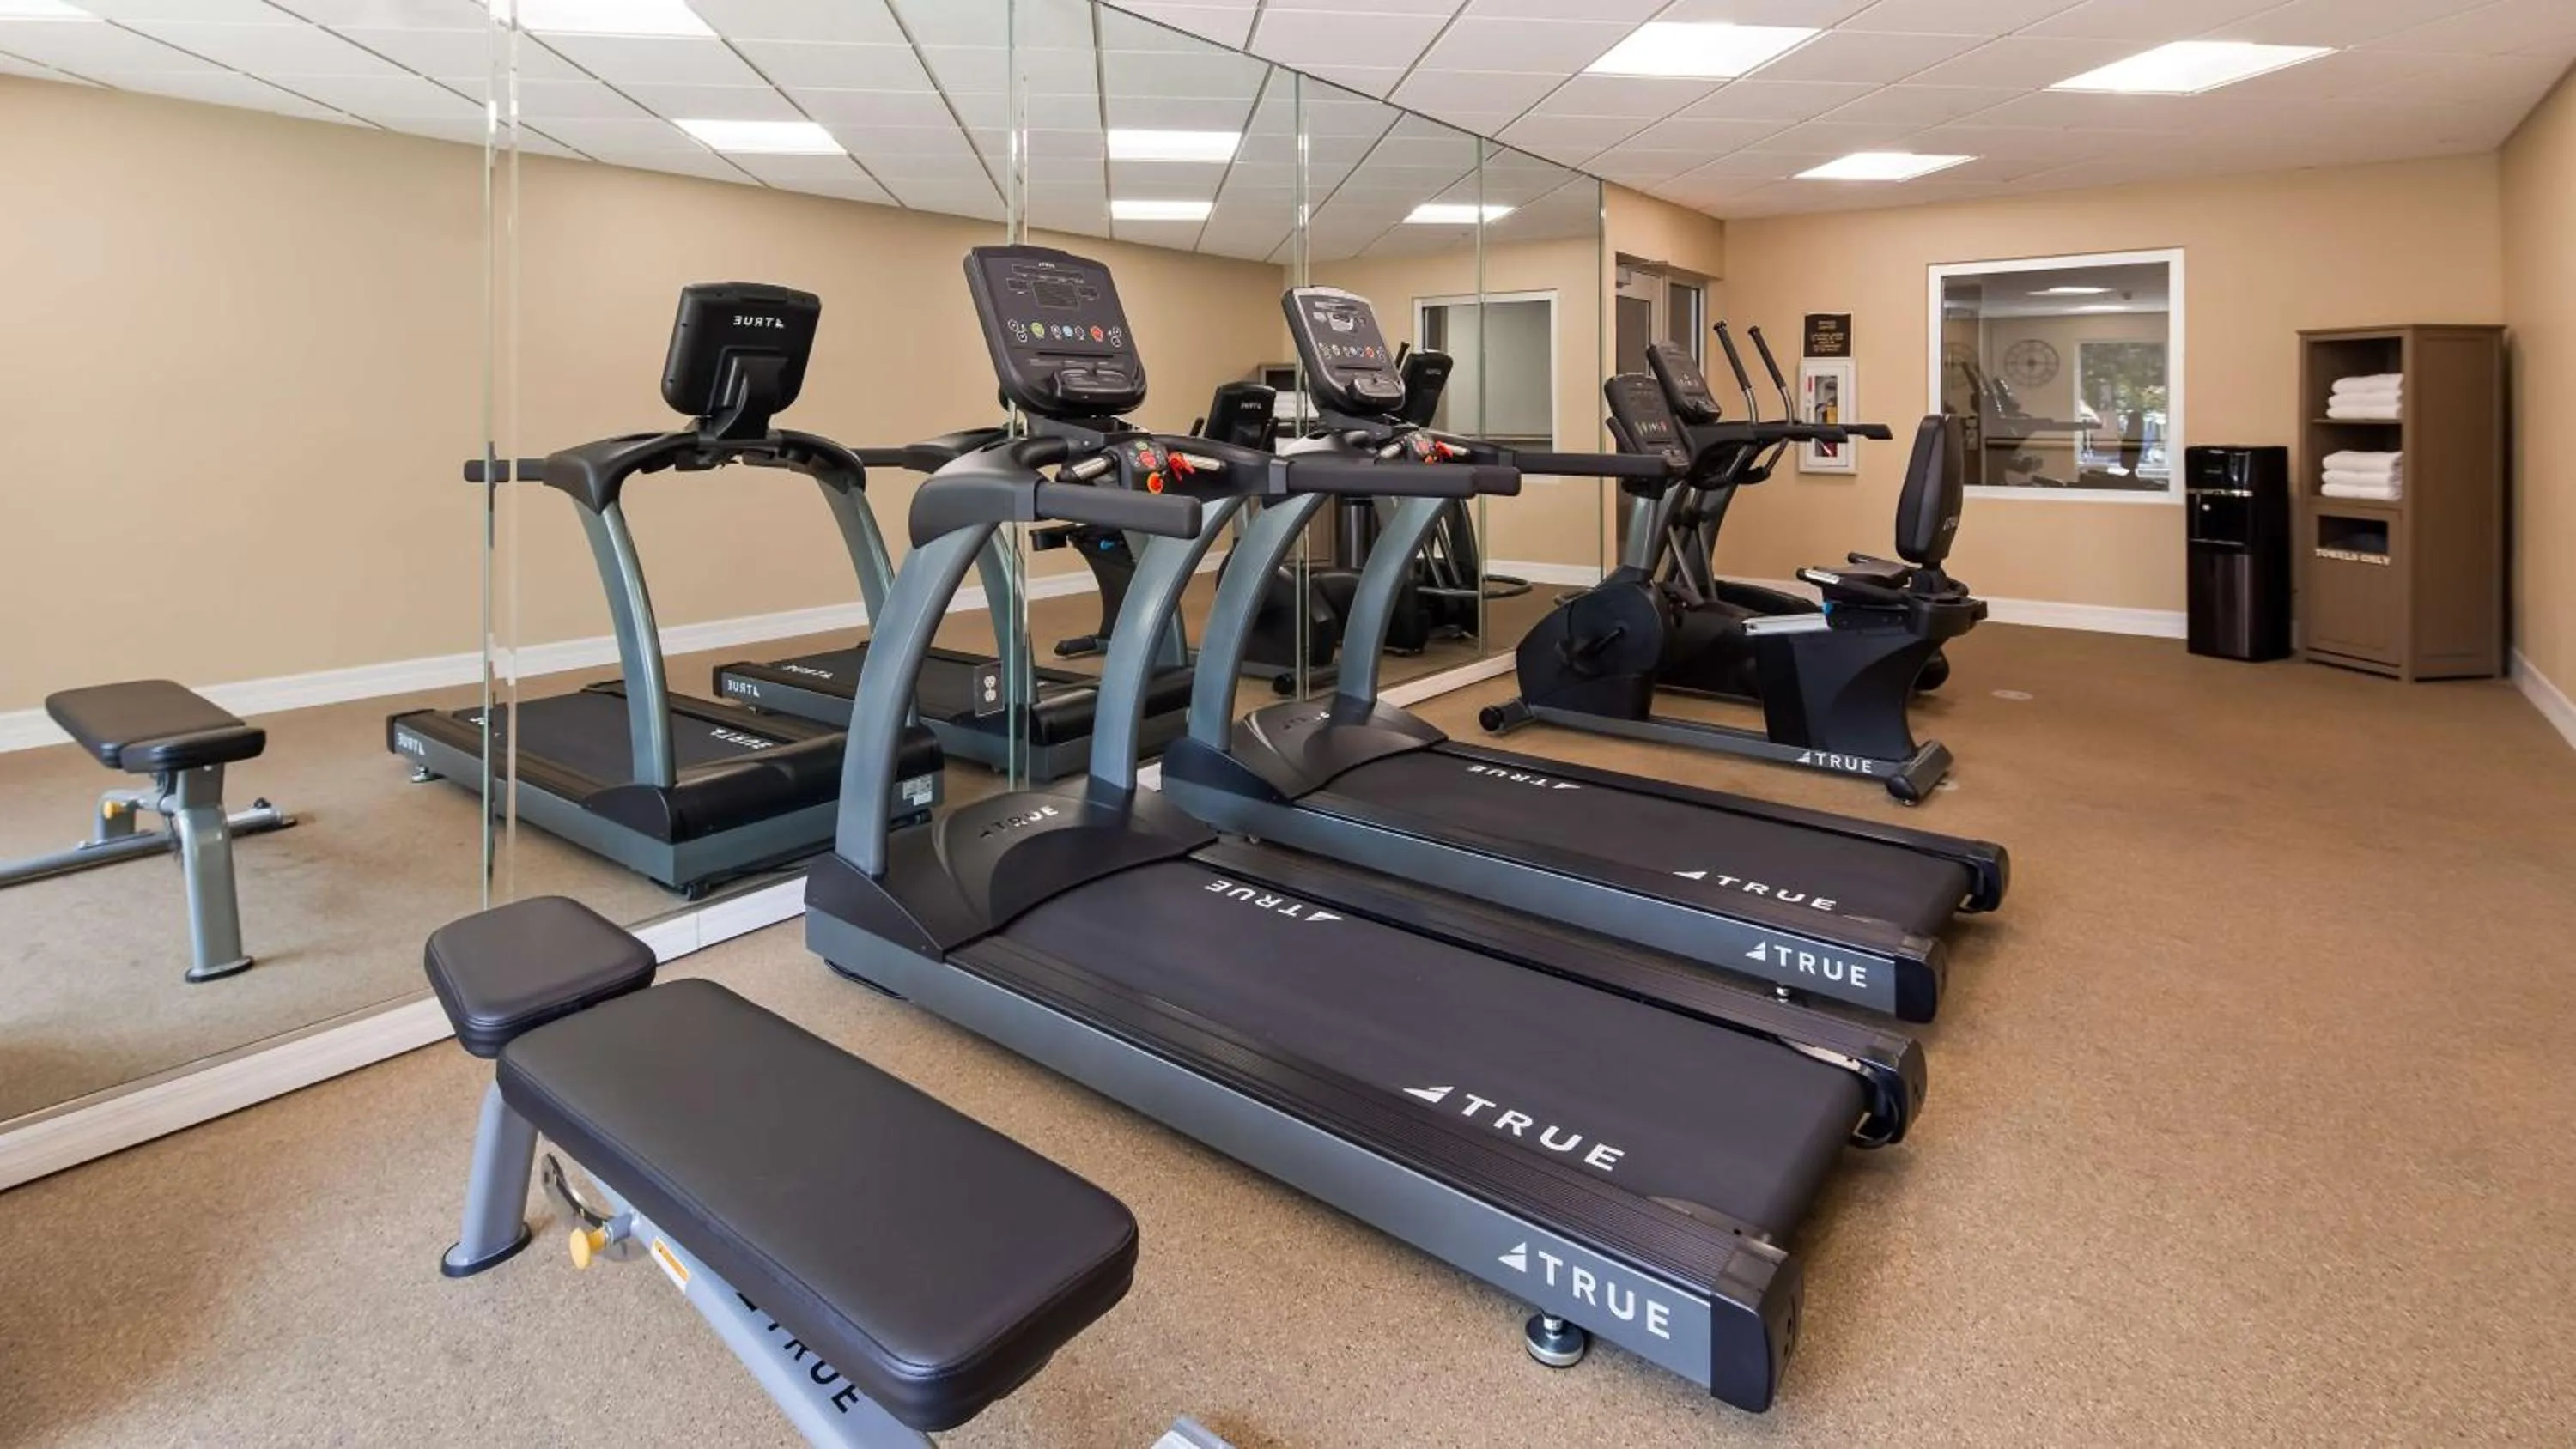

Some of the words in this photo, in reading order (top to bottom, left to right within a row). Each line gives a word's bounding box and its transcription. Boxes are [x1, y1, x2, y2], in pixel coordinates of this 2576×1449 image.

[2360, 554, 2391, 566] ONLY
[1814, 751, 1873, 773] TRUE
[1204, 880, 1303, 917] TRUE
[1717, 875, 1837, 911] TRUE
[1774, 944, 1868, 988] TRUE
[1461, 1093, 1625, 1171] TRUE
[1538, 1250, 1670, 1339] TRUE
